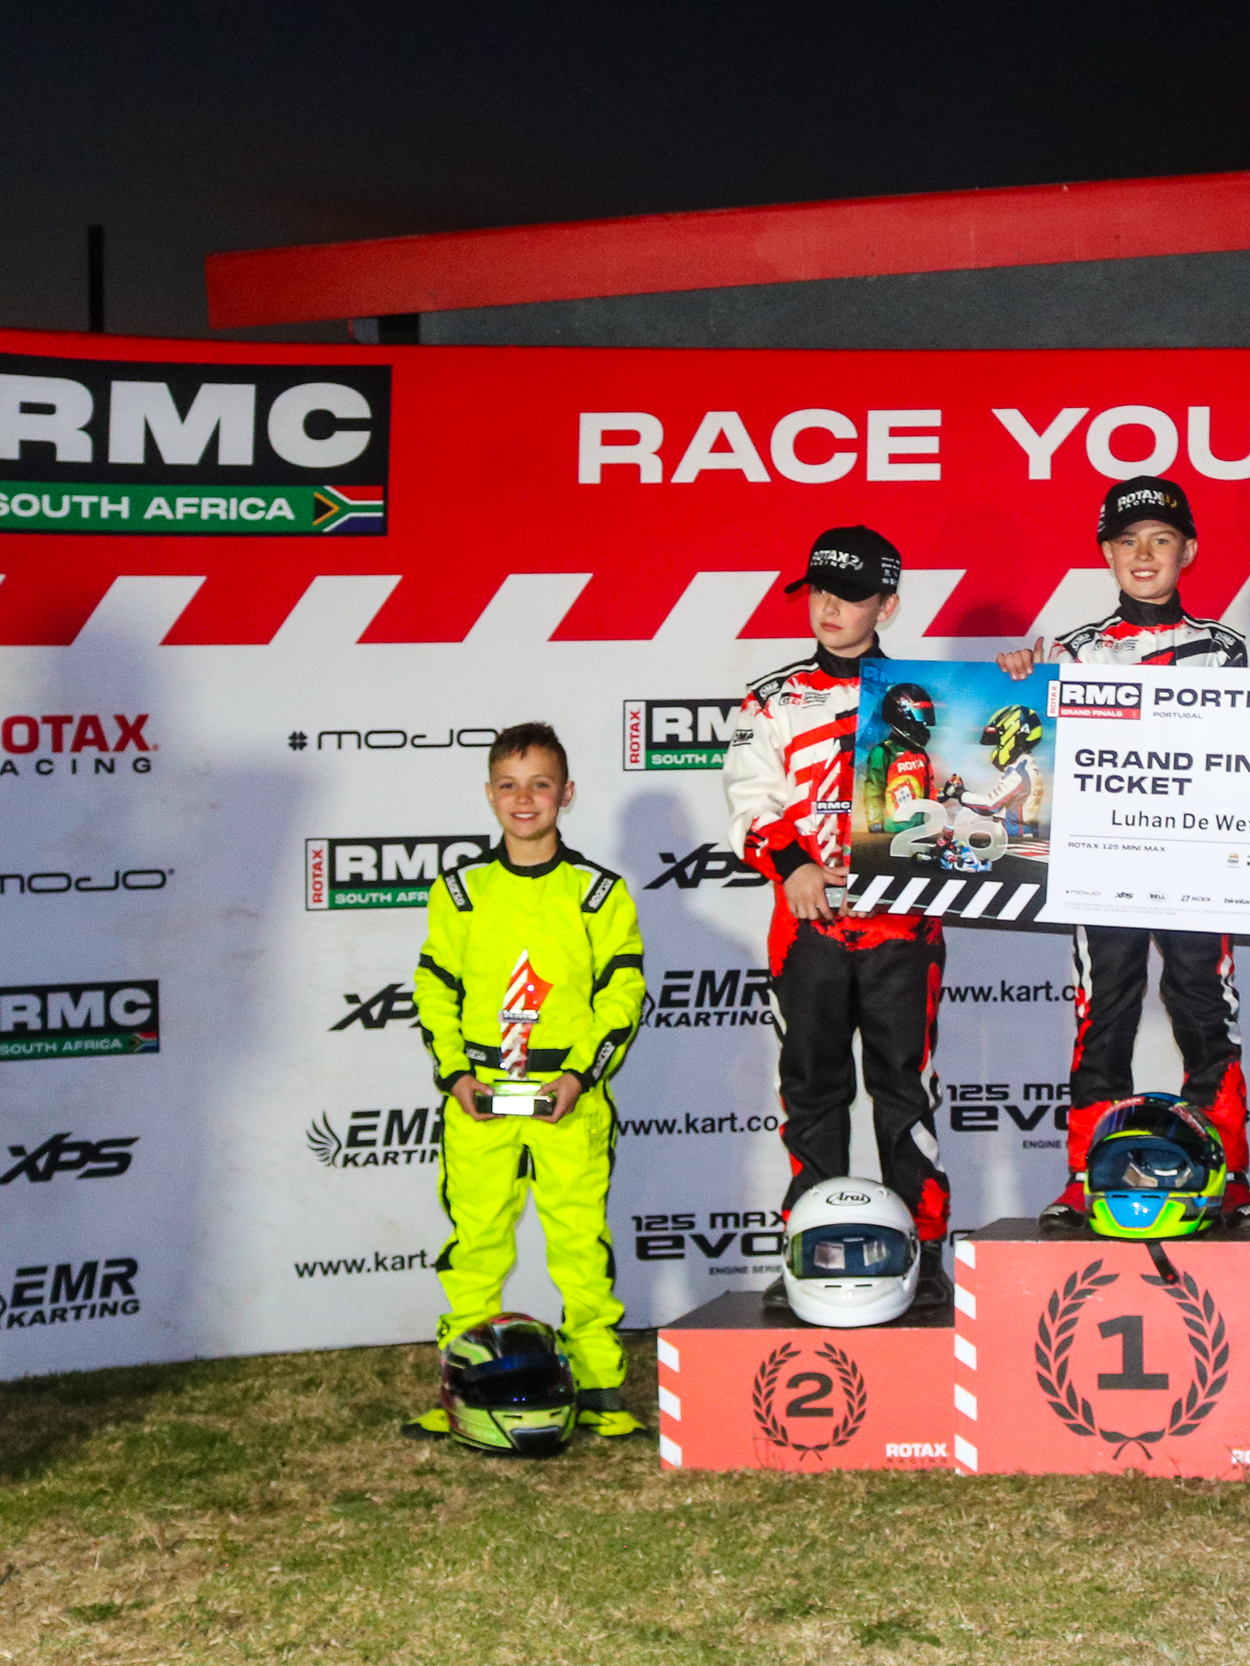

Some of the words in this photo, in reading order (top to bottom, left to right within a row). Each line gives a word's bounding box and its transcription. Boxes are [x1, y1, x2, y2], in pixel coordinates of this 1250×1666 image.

[0, 373, 372, 469] RMC
[578, 408, 942, 485] RACE
[143, 496, 296, 520] AFRICA
[1061, 683, 1141, 707] RMC
[1153, 711, 1203, 719] PORTUGAL
[1, 714, 151, 755] OTAX
[629, 709, 641, 764] ROTAX
[651, 753, 708, 765] SOUTH
[1075, 749, 1193, 770] GRAND
[1074, 773, 1192, 796] TICKET
[1111, 809, 1176, 829] Luhan
[1182, 812, 1210, 831] De
[312, 848, 323, 903] ROTAX
[335, 890, 392, 904] SOUTH
[0, 987, 152, 1034] RMC
[327, 982, 421, 1032] XP
[654, 1010, 775, 1028] KARTING
[62, 1037, 123, 1052] AFRICA
[946, 1083, 1010, 1101] 125
[1022, 1140, 1062, 1149] ENGINE
[0, 1131, 141, 1185] XPS
[631, 1213, 696, 1232] 125
[11, 1257, 139, 1309] EMR
[708, 1266, 749, 1276] ENGINE
[6, 1299, 141, 1330] KARTING
[1097, 1314, 1170, 1391] 1
[785, 1371, 835, 1418] 2
[886, 1443, 948, 1458] ROTAX
